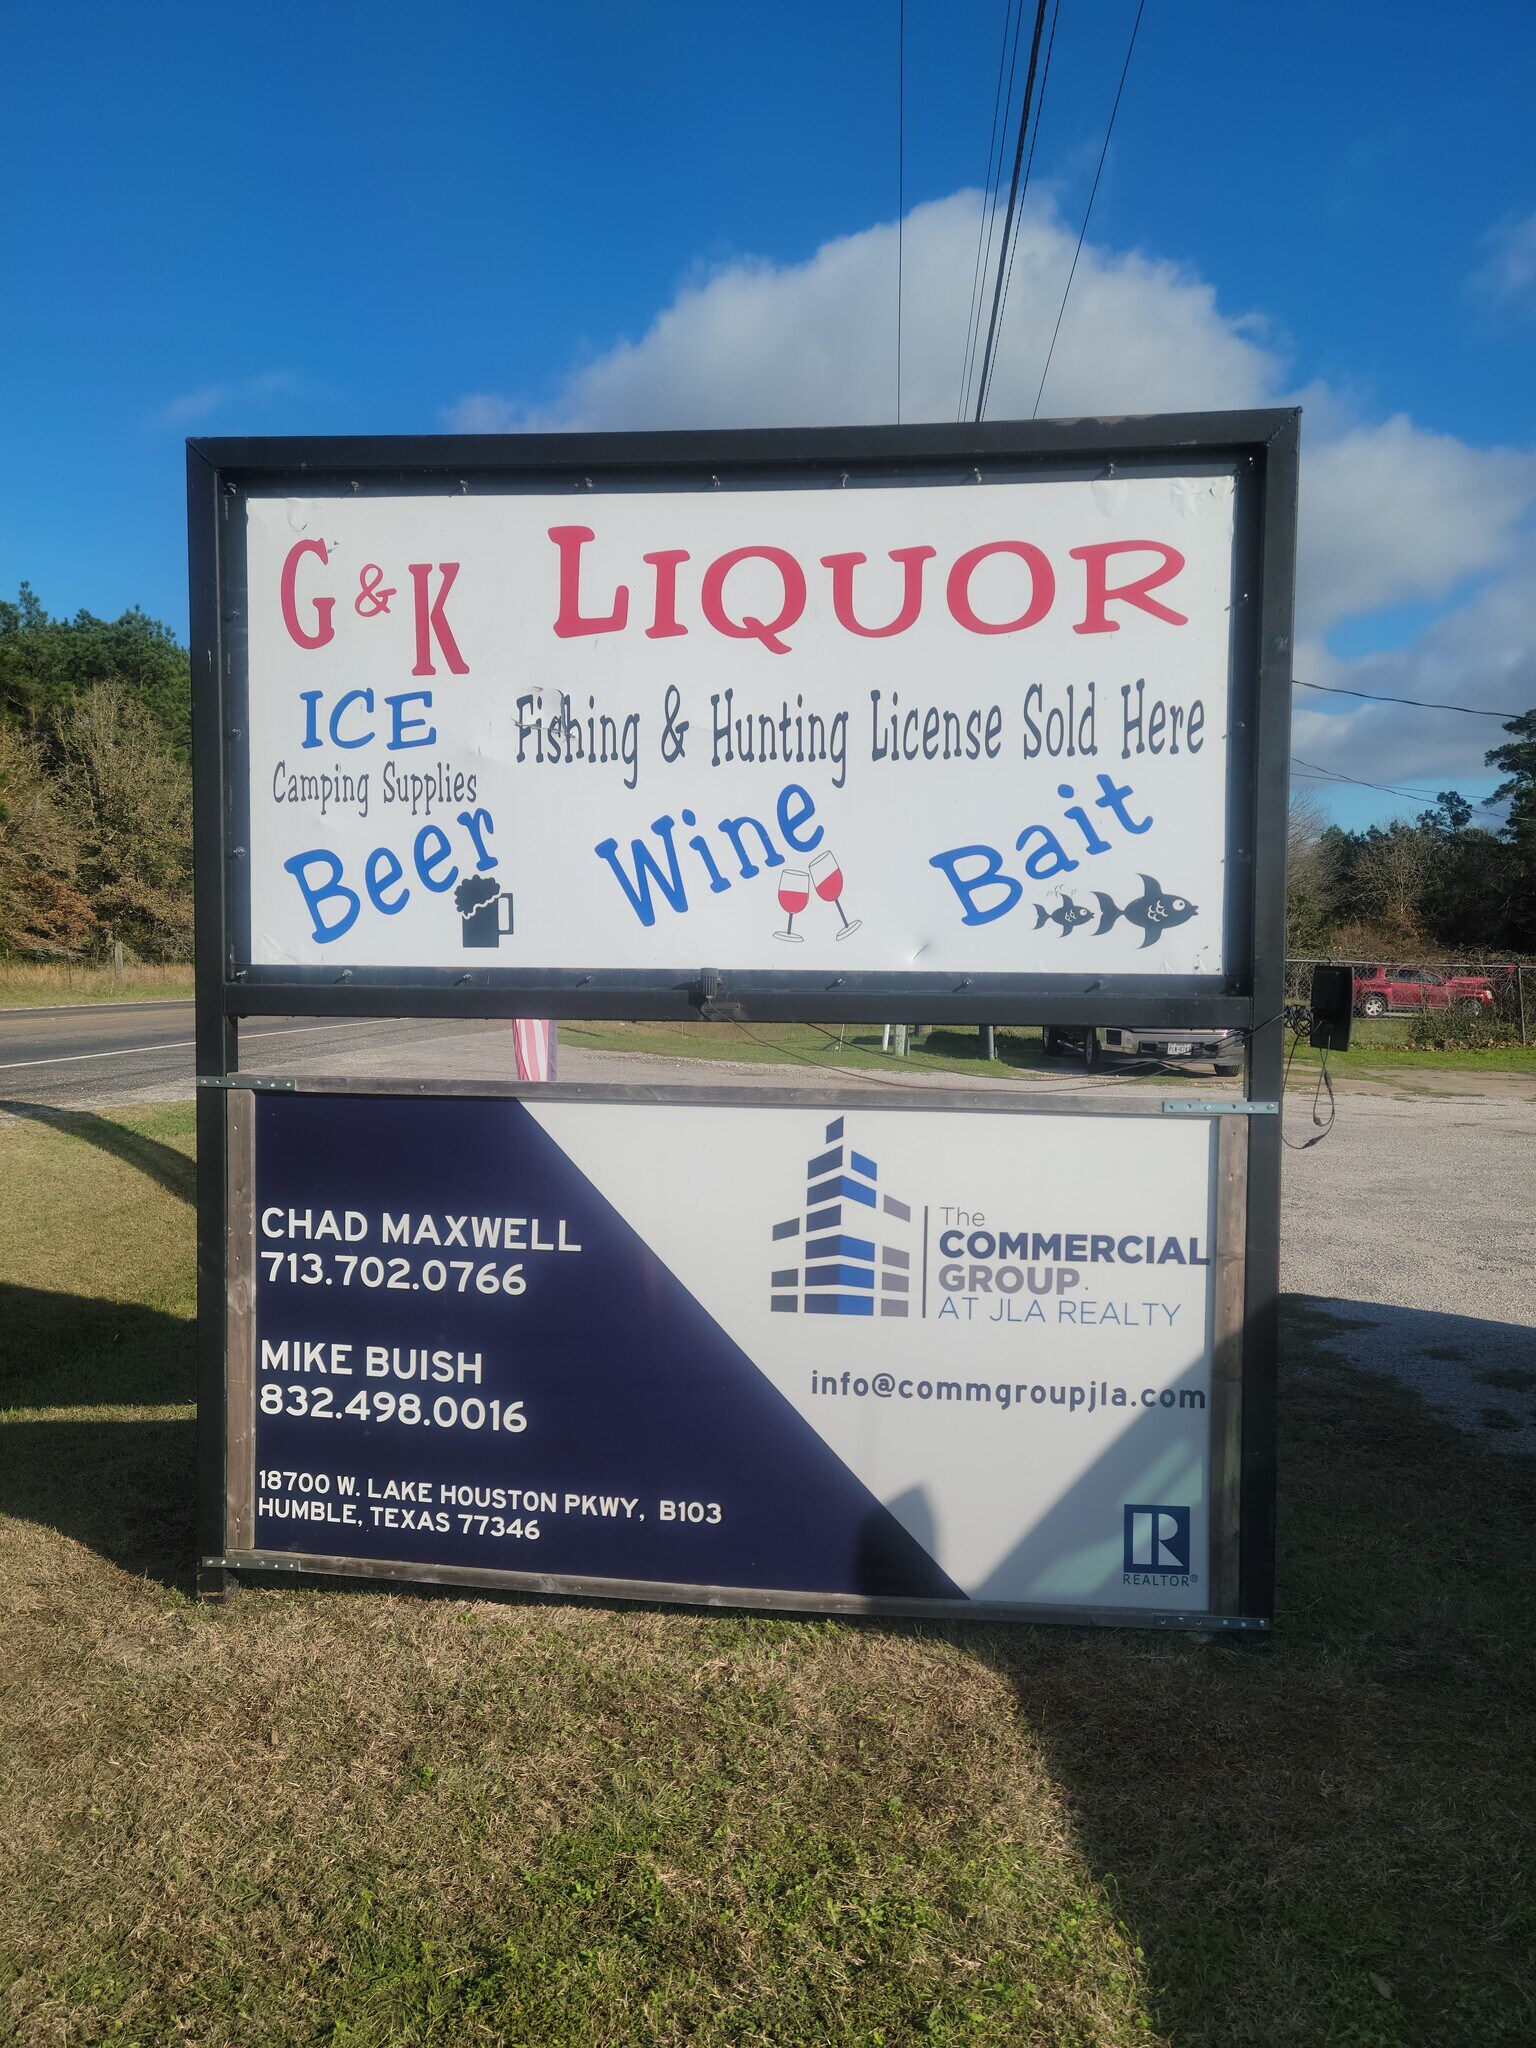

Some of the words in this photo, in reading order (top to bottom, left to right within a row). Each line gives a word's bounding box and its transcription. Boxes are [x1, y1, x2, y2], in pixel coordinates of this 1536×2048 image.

[547, 525, 1189, 655] LIQUOR
[299, 687, 437, 750] ICE
[515, 693, 641, 790] Fishing
[661, 684, 690, 763] &
[710, 687, 849, 789] Hunting
[870, 689, 1002, 762] License
[1023, 682, 1098, 760] Sold
[1121, 678, 1205, 760] Here
[272, 760, 370, 817] Camping
[383, 761, 478, 816] Supplies
[594, 783, 825, 927] Wine
[928, 773, 1154, 927] Bait
[283, 807, 499, 944] Beer
[261, 1207, 368, 1242] CHAD
[382, 1213, 582, 1252] MAXWELL
[940, 1206, 986, 1227] The
[939, 1230, 1211, 1266] COMMERCIAL
[260, 1251, 527, 1296] 713.702.0766
[938, 1296, 979, 1320] AT
[989, 1298, 1046, 1322] JLA
[1058, 1301, 1182, 1327] REALTY
[261, 1340, 353, 1375] MIKE
[366, 1347, 482, 1385] BUISH
[260, 1384, 528, 1433] 832.498.0016
[811, 1370, 1207, 1413] info@commgroupjla.com
[259, 1470, 330, 1494] 18700
[337, 1476, 361, 1497] W.
[368, 1479, 433, 1503] LAKE
[440, 1485, 557, 1513] HOUSTON
[565, 1494, 645, 1522] PKWY,
[660, 1501, 722, 1524] B103
[259, 1498, 363, 1528] HUMBLE,
[370, 1507, 450, 1532] TEXAS
[457, 1514, 541, 1540] 77346
